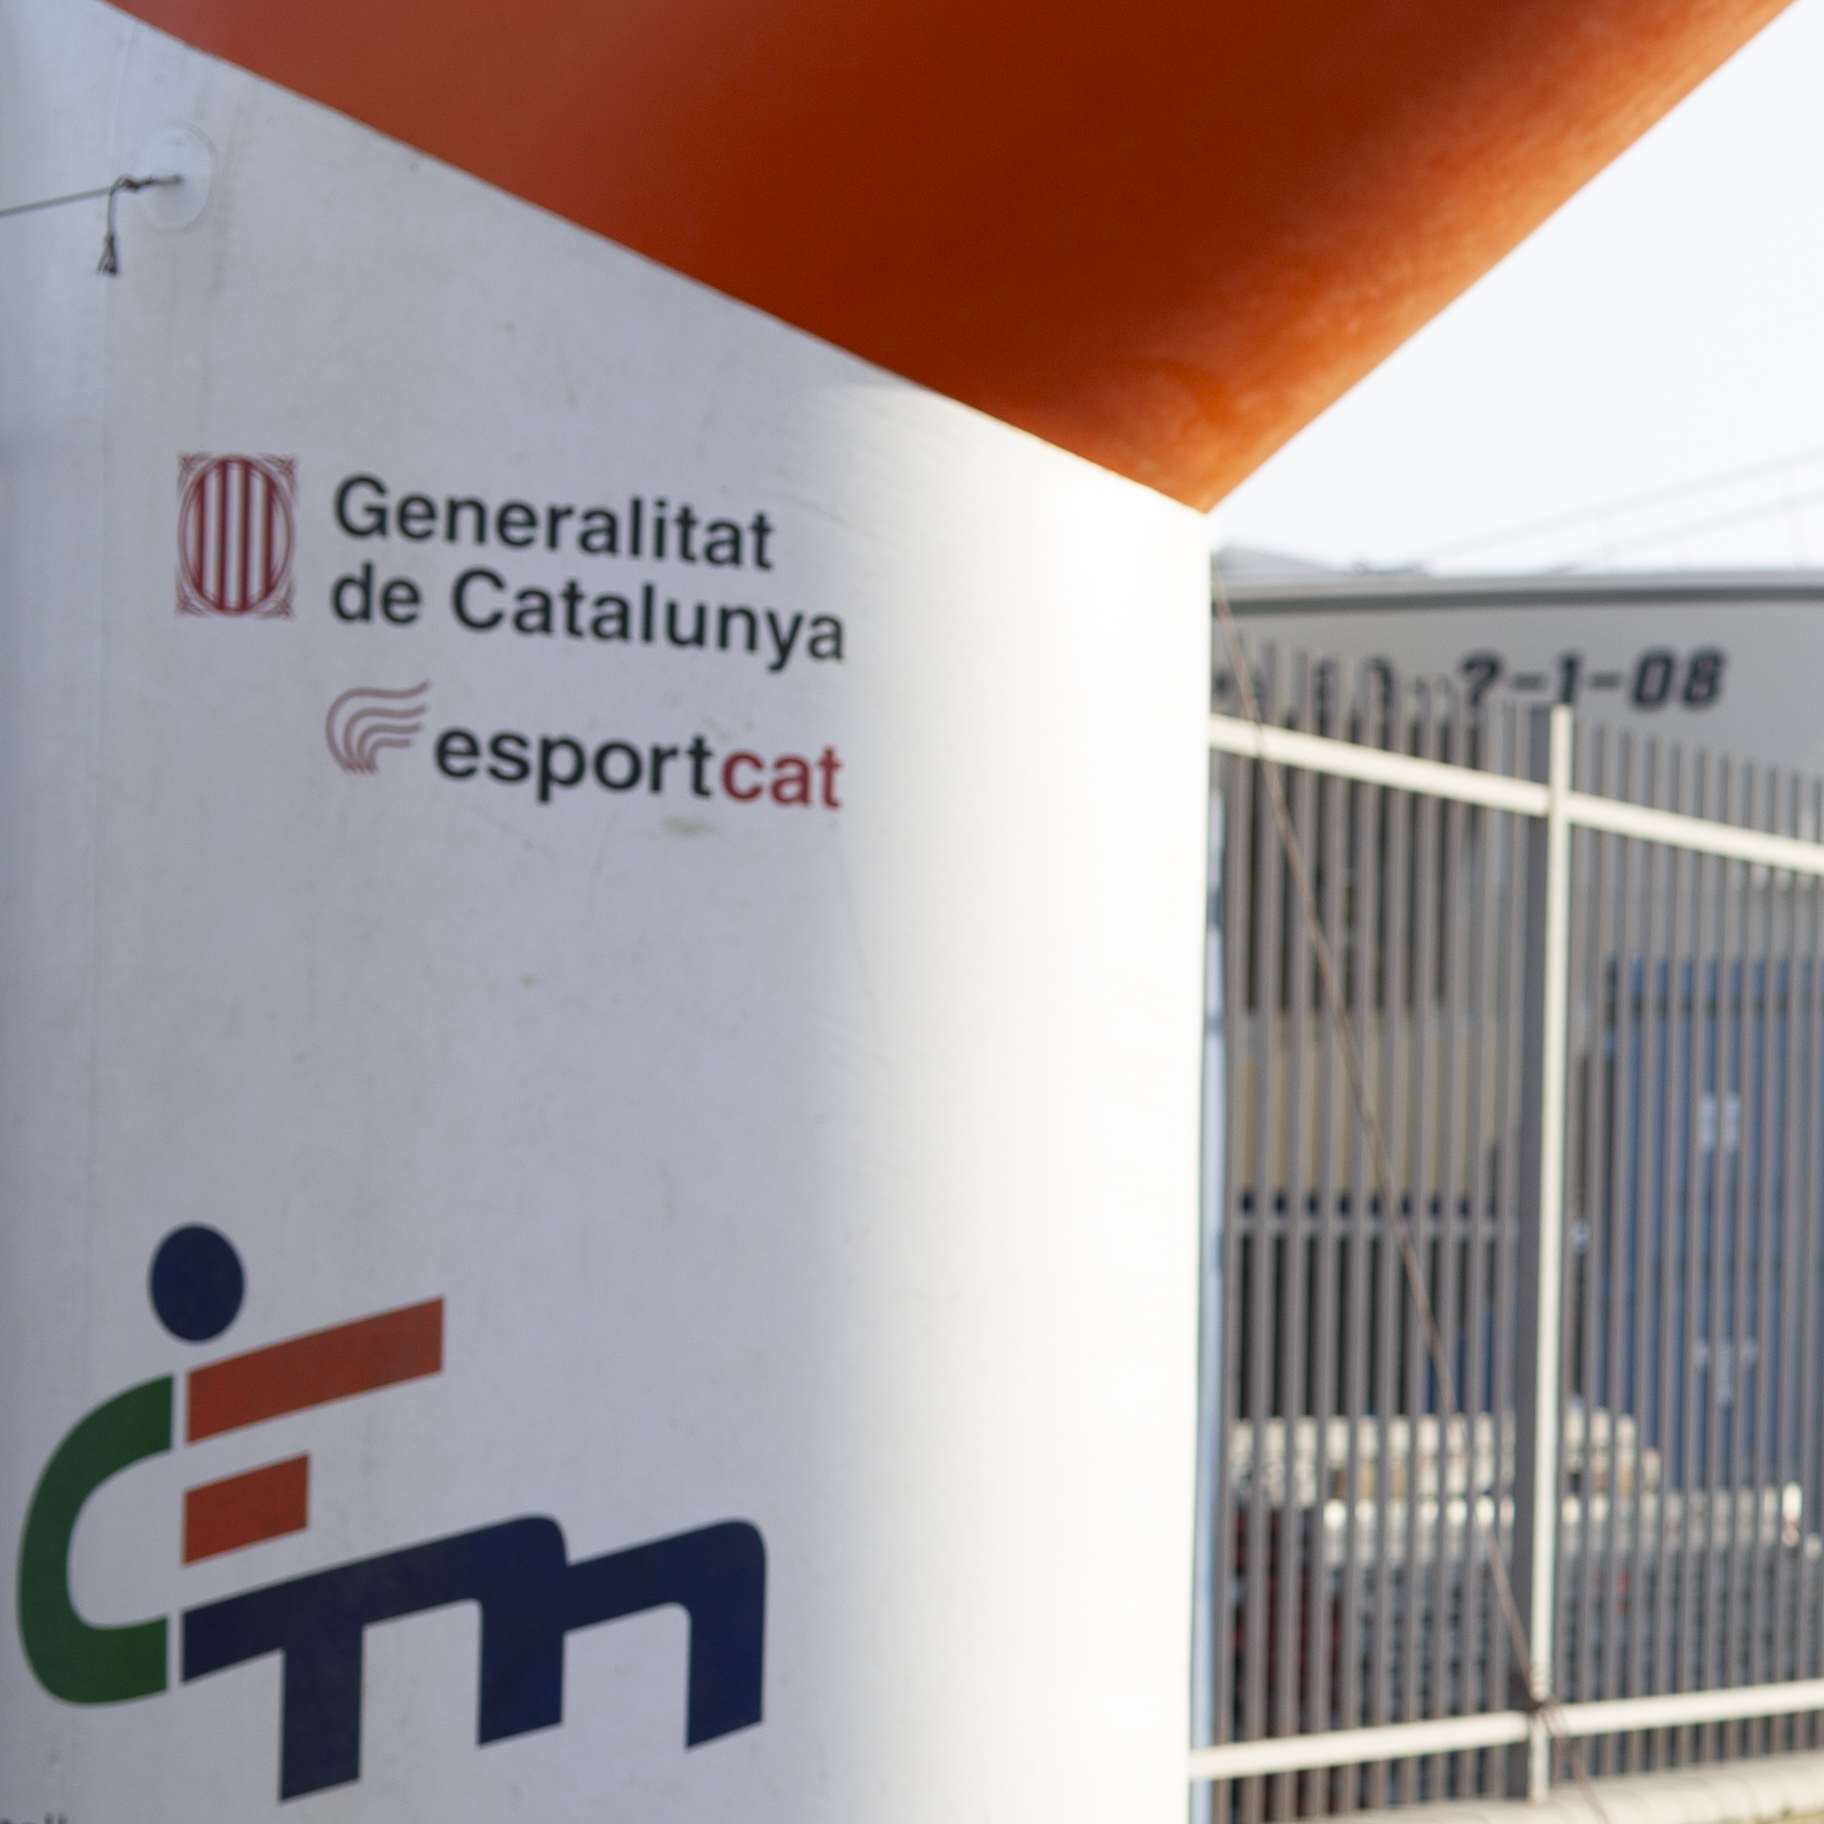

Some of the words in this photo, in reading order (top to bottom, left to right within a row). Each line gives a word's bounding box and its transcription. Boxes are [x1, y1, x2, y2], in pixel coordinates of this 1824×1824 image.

[332, 471, 776, 573] Generalitat
[328, 559, 424, 628] de
[449, 566, 846, 676] Catalunya
[432, 726, 844, 812] esportcat
